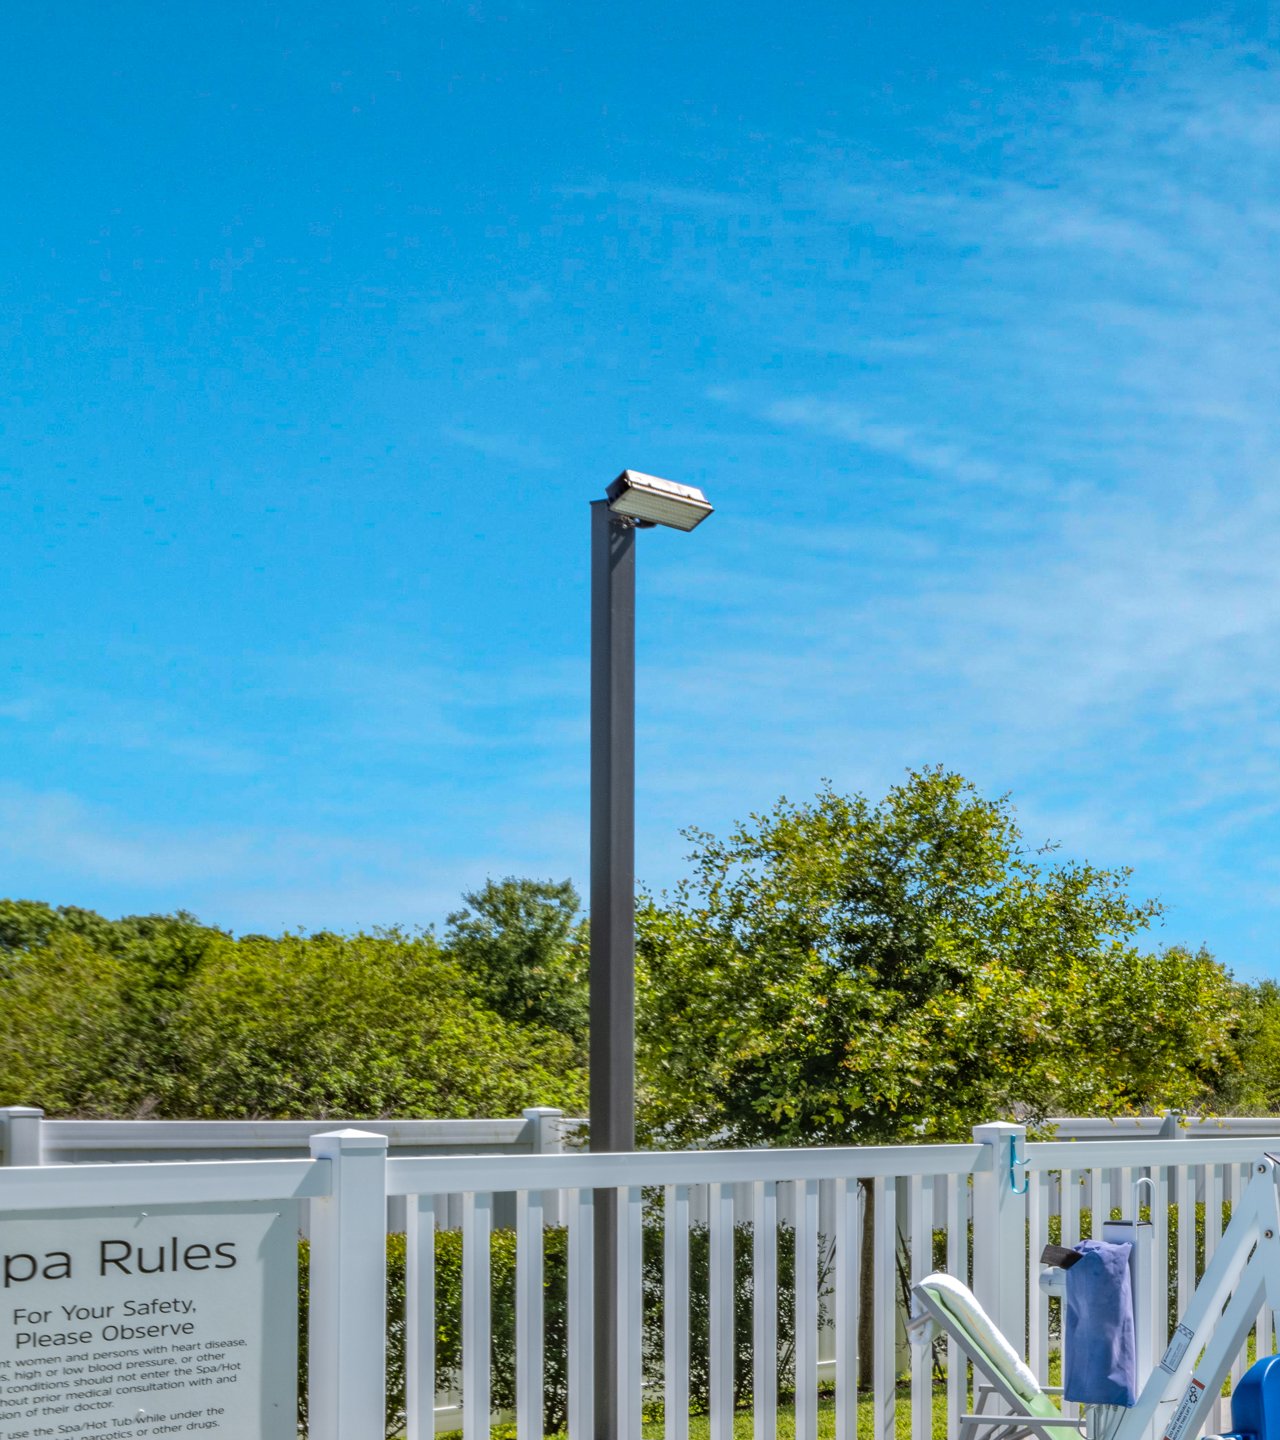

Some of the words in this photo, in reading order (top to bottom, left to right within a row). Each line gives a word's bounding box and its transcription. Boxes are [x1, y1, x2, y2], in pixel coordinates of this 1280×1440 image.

[99, 1236, 237, 1276] Rules
[13, 1308, 53, 1325] For
[61, 1304, 115, 1321] Your
[123, 1298, 197, 1317] Safety,
[15, 1330, 93, 1349] Please
[102, 1321, 195, 1342] Observe
[14, 1370, 42, 1380] high
[46, 1369, 58, 1377] or
[63, 1367, 84, 1375] low
[88, 1362, 122, 1373] blood
[181, 1356, 193, 1364] or
[196, 1352, 226, 1362] other
[15, 1356, 61, 1366] women
[65, 1353, 89, 1362] and
[93, 1349, 139, 1360] persons
[143, 1345, 168, 1355] with
[171, 1342, 201, 1352] heart
[205, 1339, 248, 1350] disease,
[7, 1380, 70, 1393] conditions
[73, 1375, 113, 1386] should
[117, 1373, 137, 1382] not
[140, 1370, 170, 1380] enter
[174, 1367, 193, 1377] the
[196, 1362, 241, 1374] Spa/Hot
[33, 1394, 62, 1404] prior
[65, 1388, 112, 1400] medical
[116, 1380, 185, 1395] consultation
[189, 1377, 213, 1387] with
[216, 1374, 237, 1384] and
[25, 1407, 39, 1417] of
[42, 1405, 69, 1416] their
[74, 1400, 115, 1412] doctor.
[7, 1431, 30, 1440] use
[33, 1427, 54, 1437] the
[58, 1421, 108, 1434] Spa/Hot
[112, 1418, 132, 1427] Tub
[135, 1413, 166, 1424] while
[170, 1410, 203, 1421] under
[206, 1407, 225, 1416] the
[136, 1429, 148, 1437] or
[152, 1424, 182, 1435] other
[186, 1420, 220, 1431] drugs.
